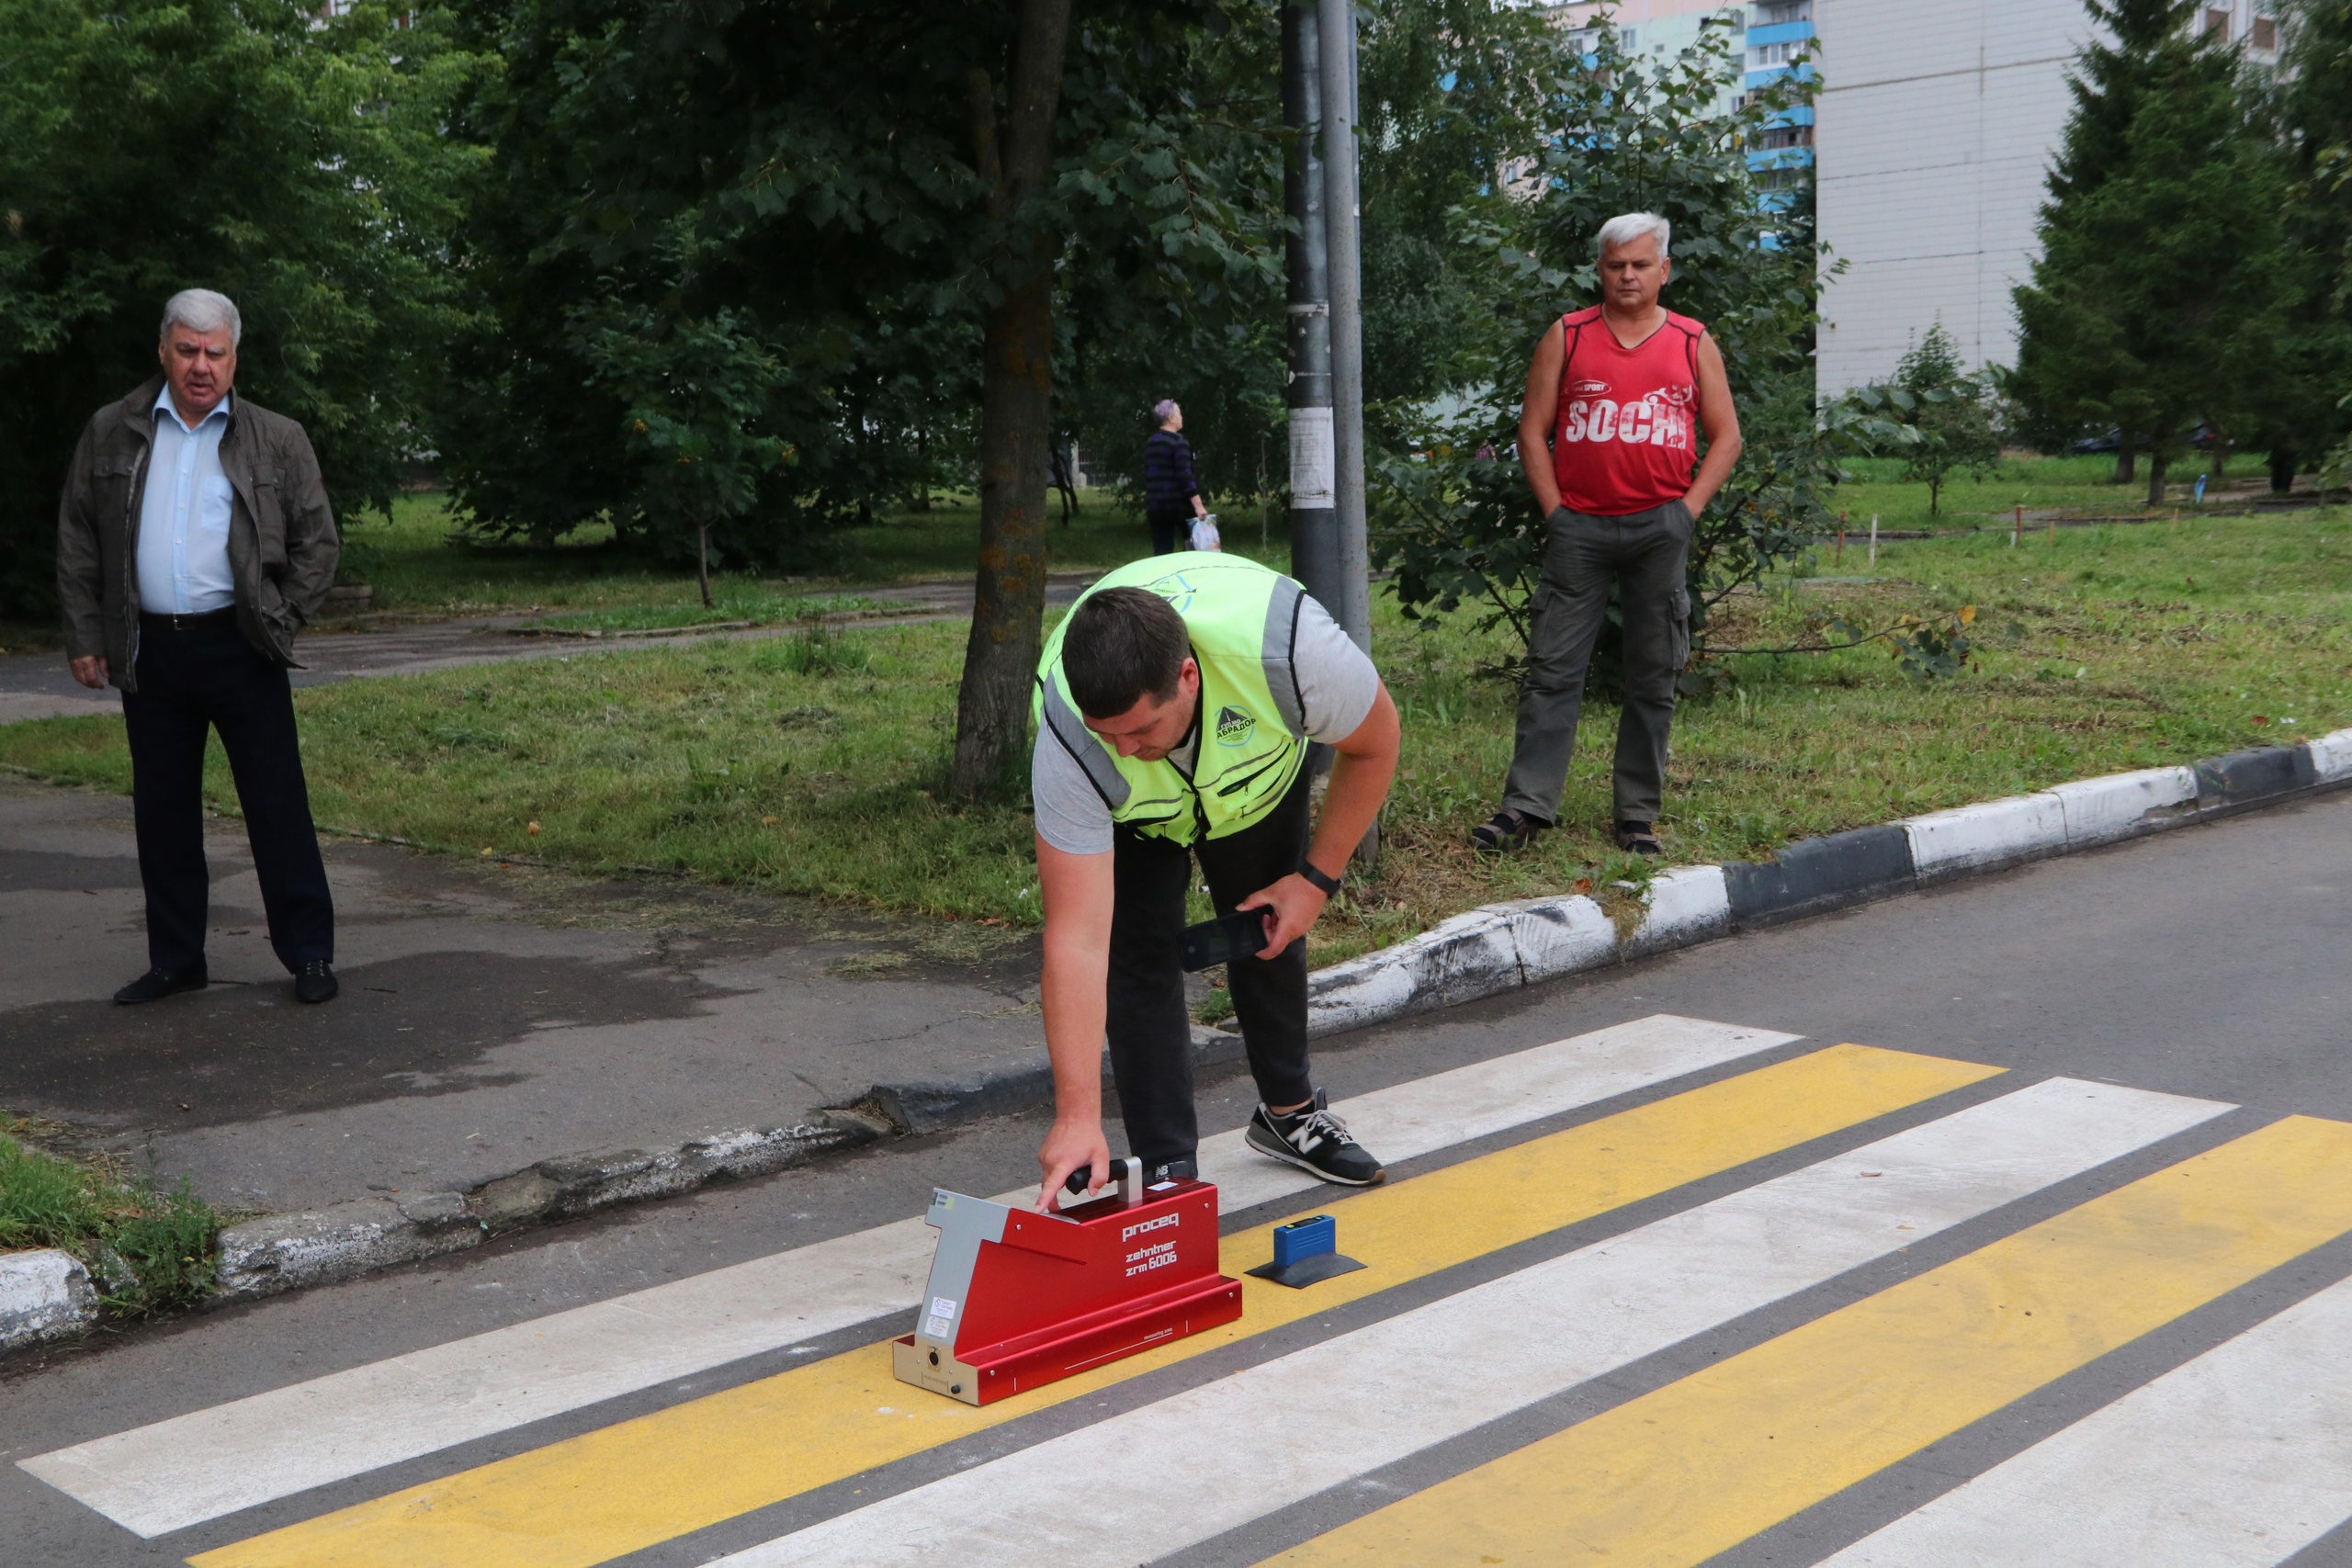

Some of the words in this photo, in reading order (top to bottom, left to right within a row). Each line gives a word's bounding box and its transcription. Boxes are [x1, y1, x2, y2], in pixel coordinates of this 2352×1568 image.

[1584, 383, 1605, 392] SPORT
[1566, 399, 1687, 449] SOCHI
[1122, 1213, 1180, 1243] proceq
[1125, 1240, 1176, 1263] zehntner
[1125, 1263, 1148, 1277] zrm
[1148, 1250, 1177, 1269] 6006
